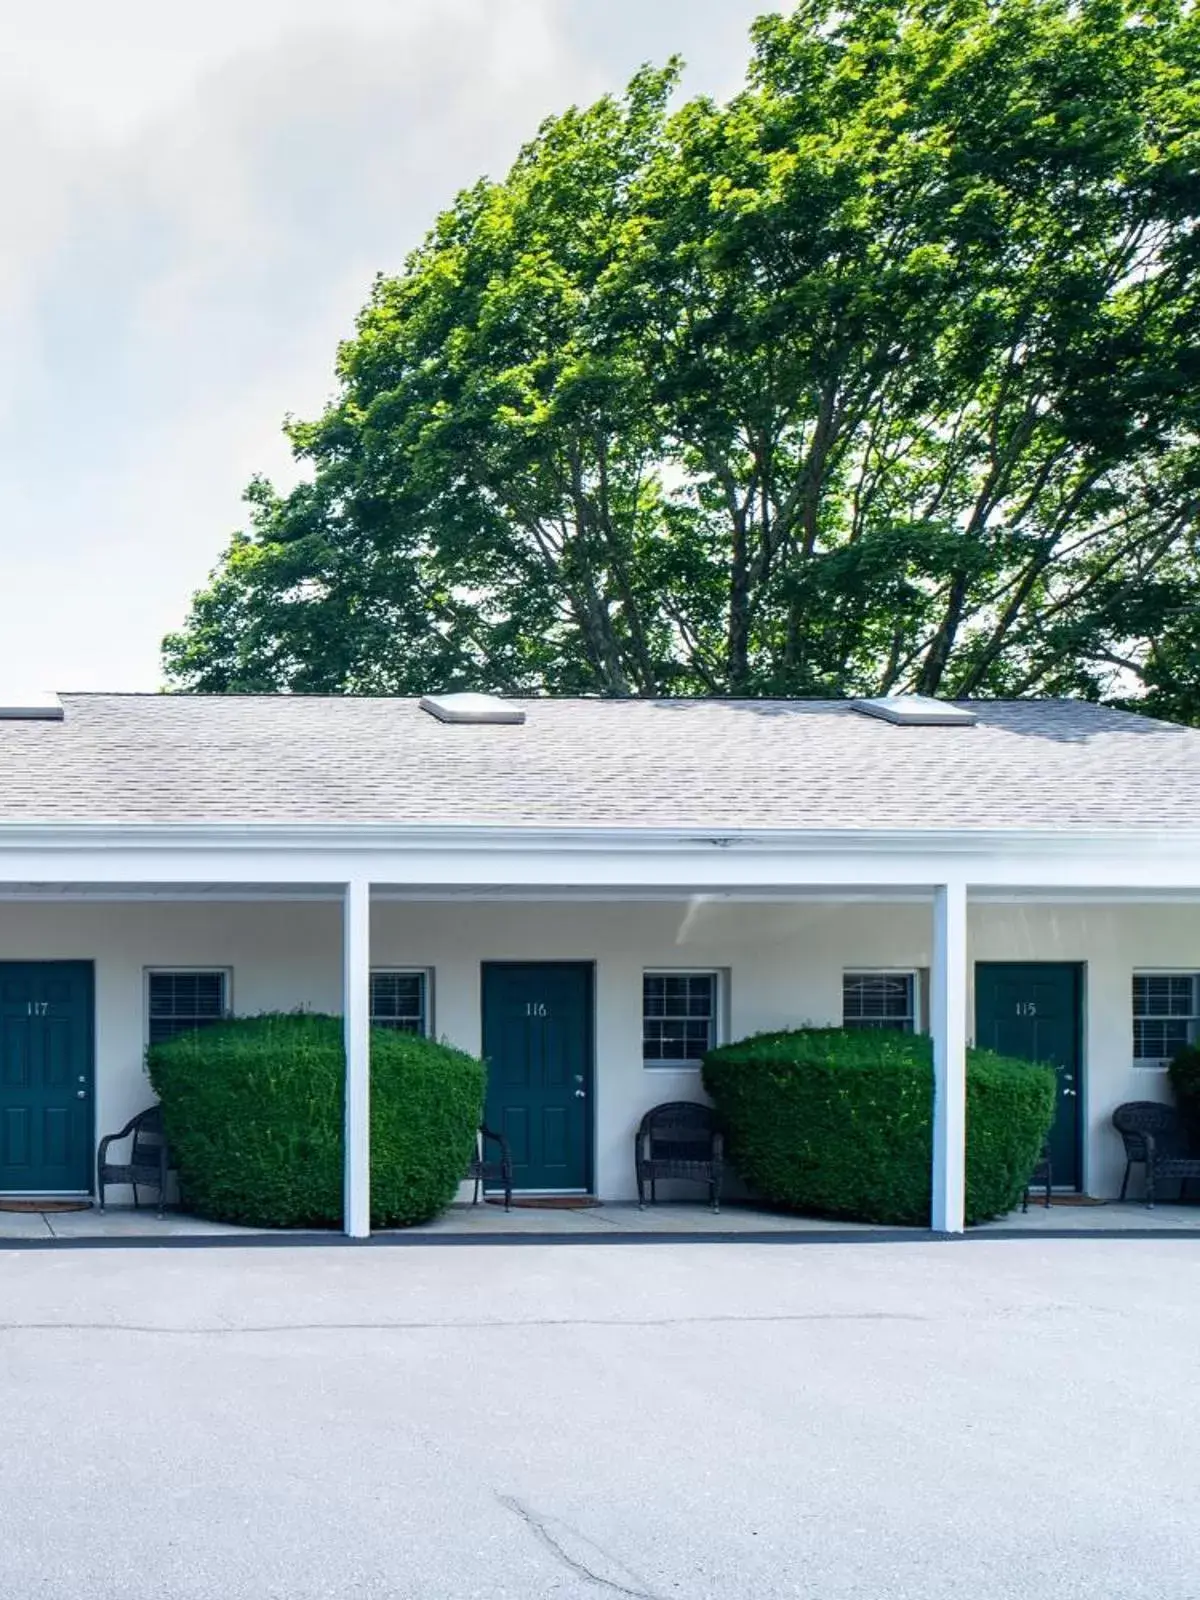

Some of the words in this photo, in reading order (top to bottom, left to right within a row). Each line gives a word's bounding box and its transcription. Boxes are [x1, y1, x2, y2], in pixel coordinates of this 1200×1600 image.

[27, 1002, 49, 1016] 117
[526, 1003, 547, 1017] 116
[1016, 1002, 1037, 1016] 115
